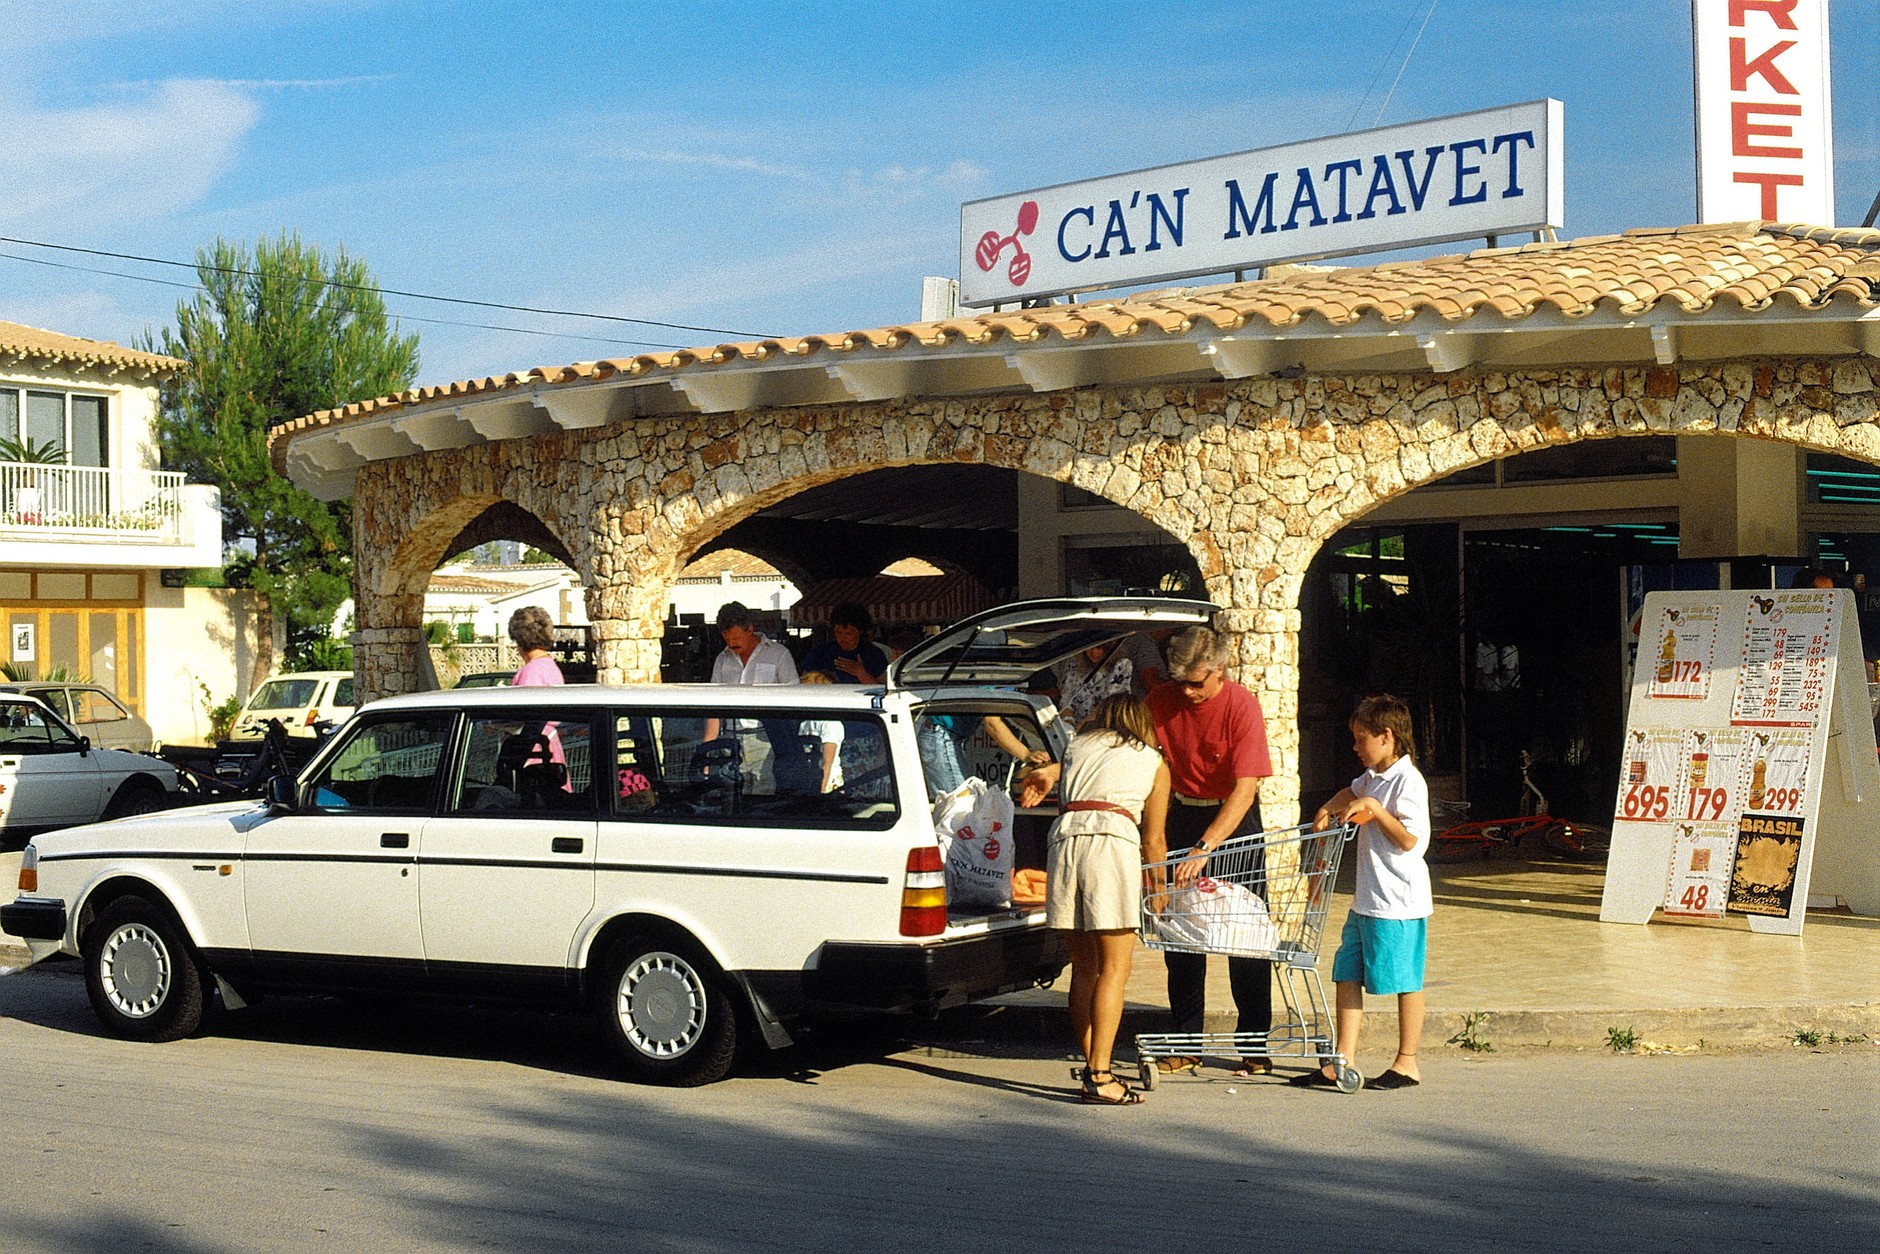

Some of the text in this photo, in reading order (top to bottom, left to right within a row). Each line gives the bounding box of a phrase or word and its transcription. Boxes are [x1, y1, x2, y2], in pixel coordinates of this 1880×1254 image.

[1224, 130, 1536, 240] MATAVET
[1773, 628, 1787, 638] 179
[1774, 640, 1785, 649] 48
[1812, 635, 1822, 645] 85
[1773, 651, 1784, 660] 69
[1806, 646, 1820, 656] 149
[1768, 661, 1783, 671] 129
[1805, 658, 1819, 667] 189
[1674, 660, 1702, 682] 172
[1807, 668, 1818, 678] 75
[1770, 676, 1780, 685] 55
[1803, 680, 1818, 690] 232
[1768, 687, 1779, 697] 69
[1806, 691, 1816, 701] 95
[1763, 698, 1778, 707] 299
[1798, 702, 1814, 712] 545
[1762, 709, 1776, 718] 172
[1624, 783, 1670, 818] 695
[1687, 787, 1728, 820] 179
[1764, 787, 1799, 811] 299
[1740, 818, 1803, 836] BRASIL
[1680, 884, 1709, 910] 48
